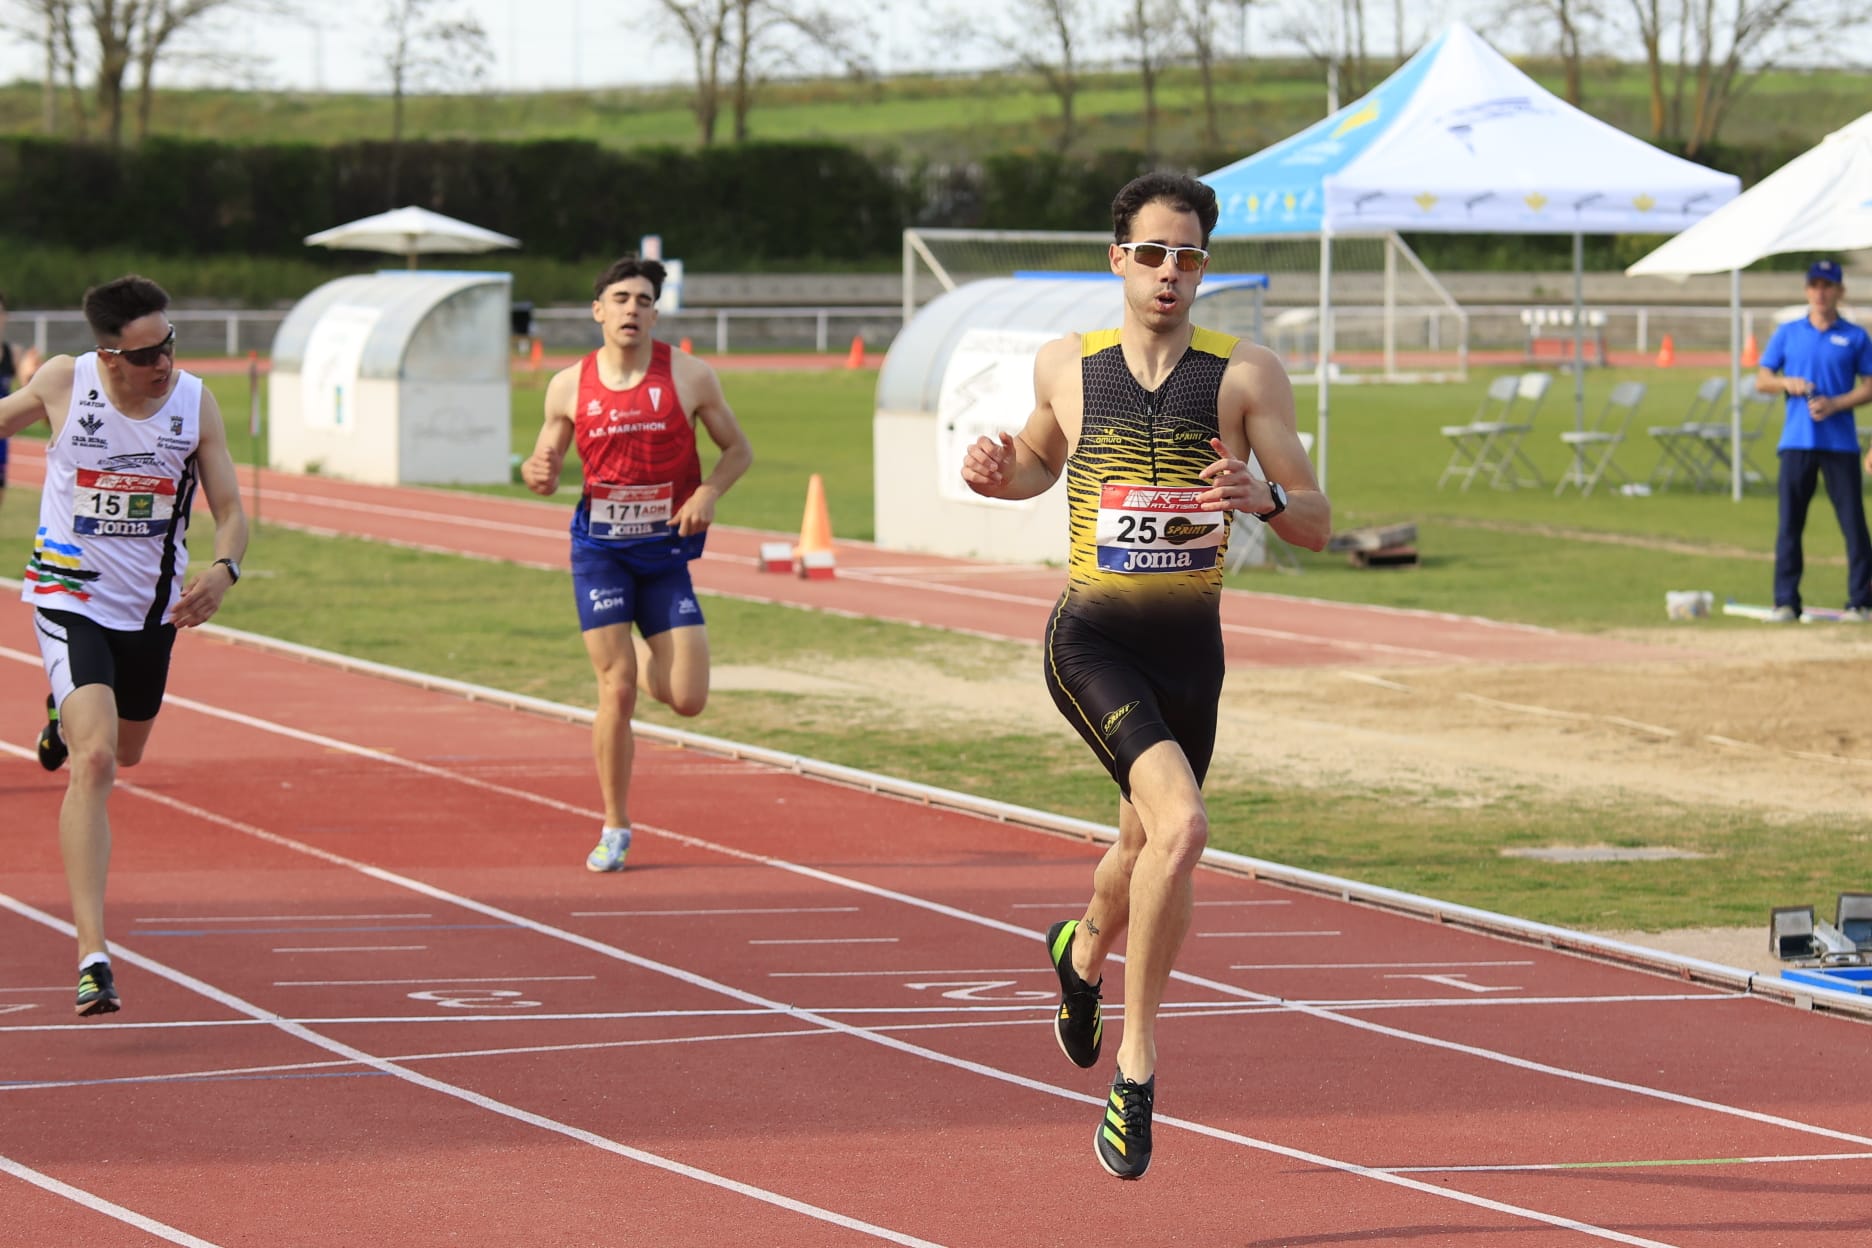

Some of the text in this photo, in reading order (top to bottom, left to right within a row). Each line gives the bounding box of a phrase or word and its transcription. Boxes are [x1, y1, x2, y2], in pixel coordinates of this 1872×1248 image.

[608, 422, 667, 434] MARATHON
[1174, 432, 1203, 441] SPRINT
[91, 493, 120, 516] 15
[641, 504, 667, 515] ADM
[1117, 515, 1157, 544] 25
[1167, 524, 1208, 536] SPRINT
[592, 597, 625, 612] ADM
